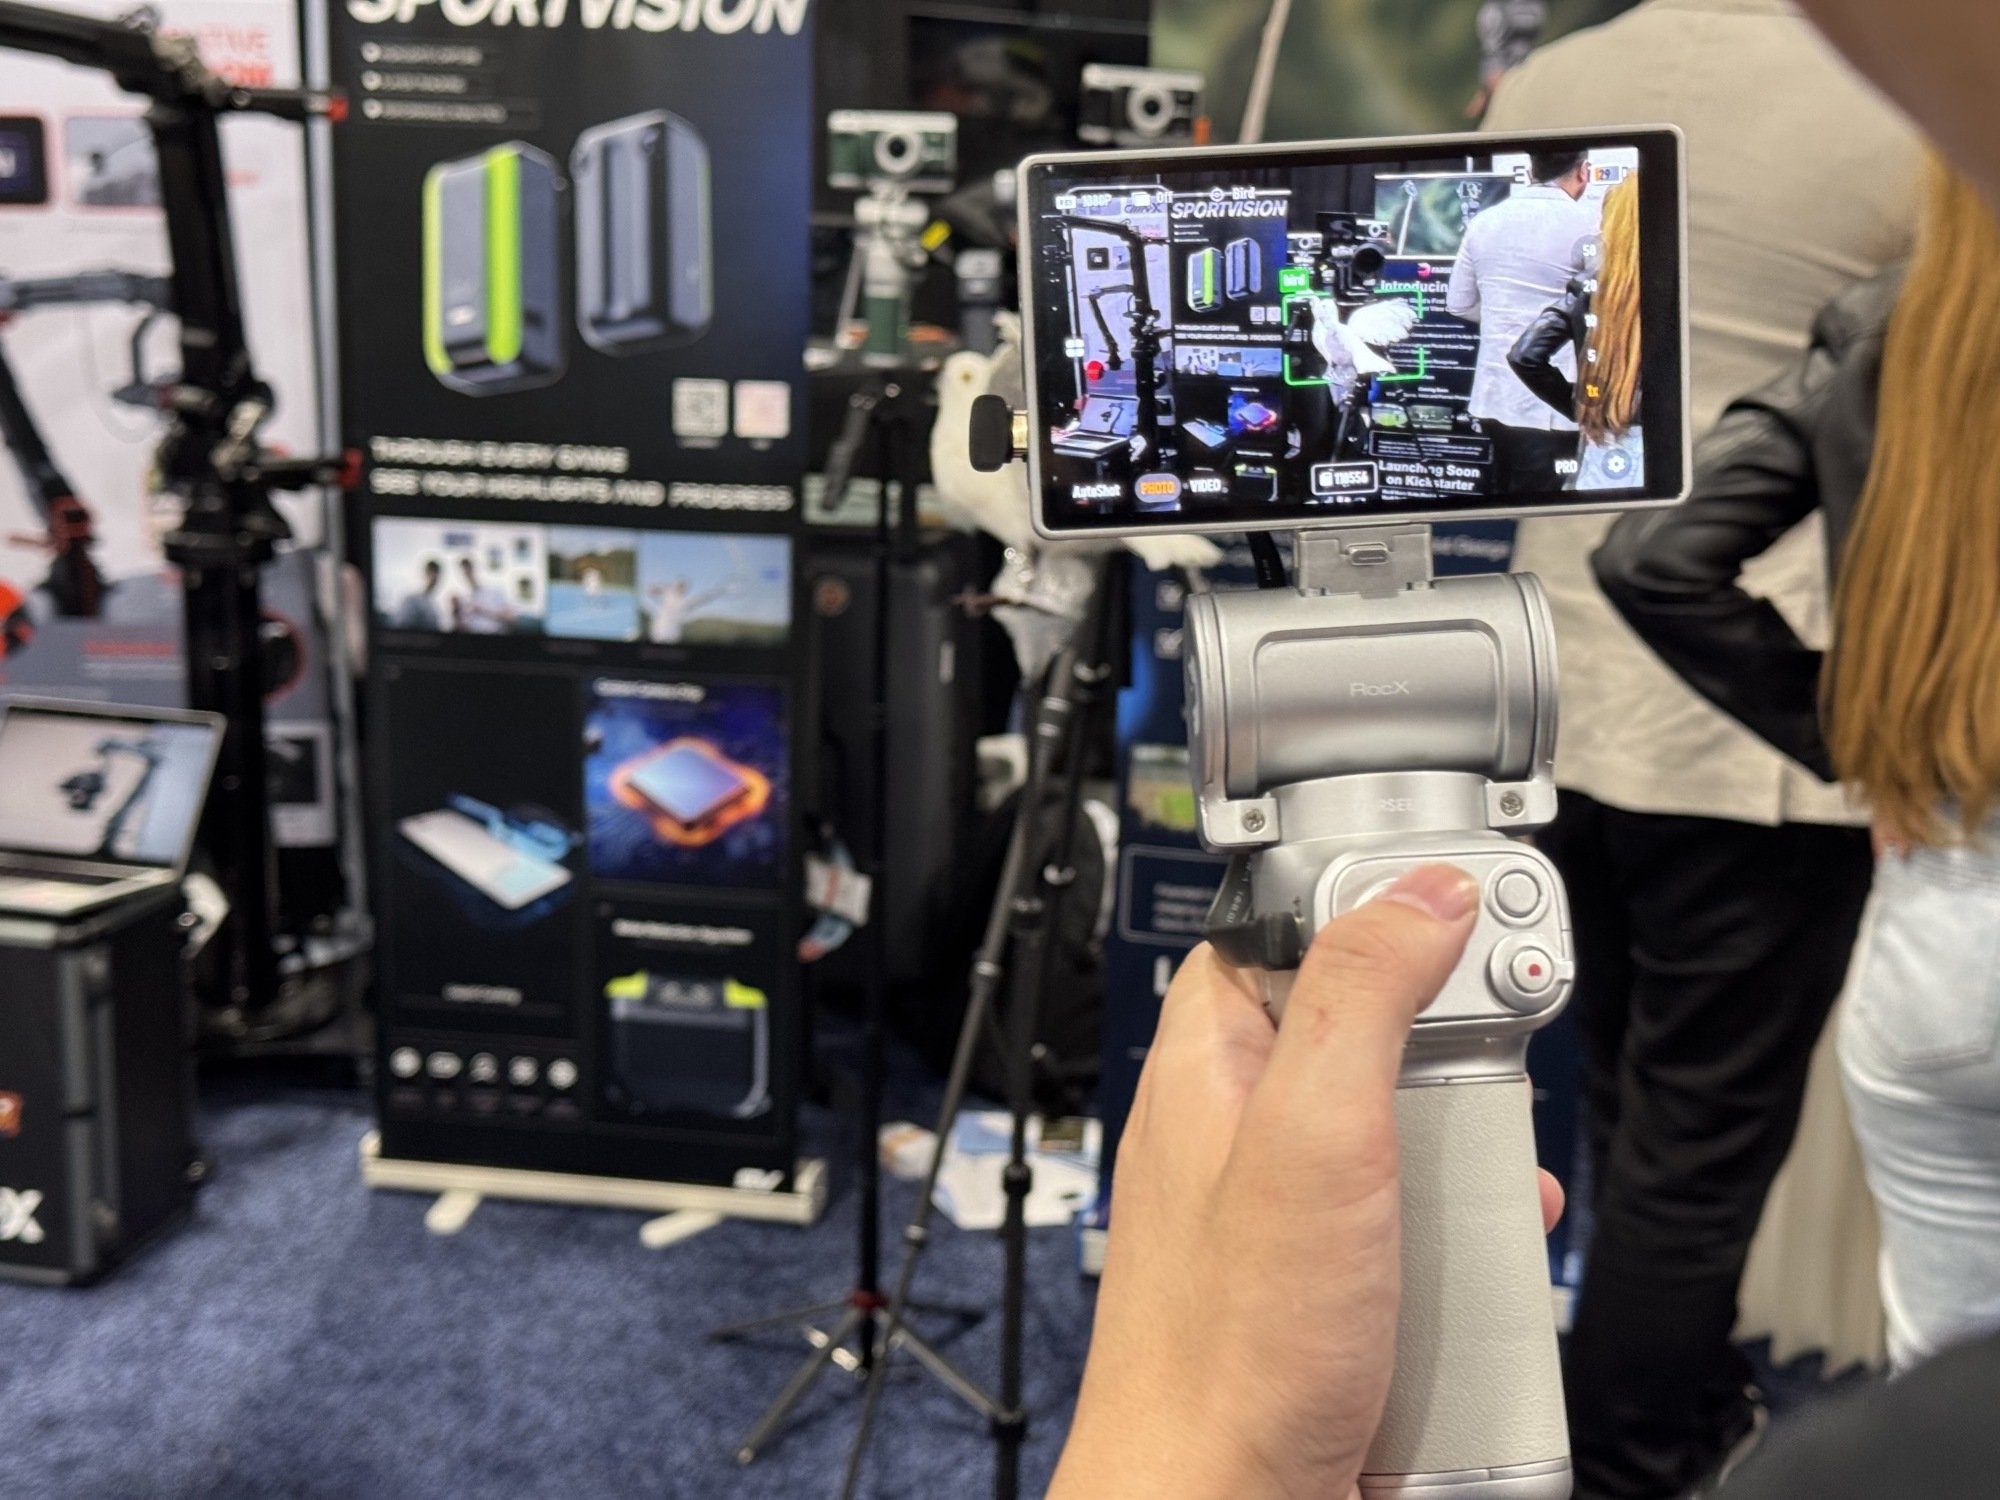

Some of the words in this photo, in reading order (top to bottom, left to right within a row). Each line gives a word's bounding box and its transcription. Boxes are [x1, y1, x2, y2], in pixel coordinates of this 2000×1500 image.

[1156, 191, 1174, 204] Off
[1231, 186, 1256, 200] Bird
[1171, 200, 1288, 219] SPORTVISION
[1583, 244, 1597, 257] 50
[1283, 273, 1305, 287] bird
[1381, 280, 1449, 293] Introducin
[1583, 280, 1598, 293] 20
[1587, 348, 1597, 362] 5
[1378, 460, 1444, 477] Launchng
[1446, 465, 1480, 478] Soon
[1555, 459, 1578, 474] PRO
[1140, 481, 1175, 495] PHOTO
[1189, 478, 1222, 493] VIDEO
[1386, 476, 1402, 486] on
[1072, 484, 1121, 499] AutoShot
[1349, 680, 1410, 697] RocX
